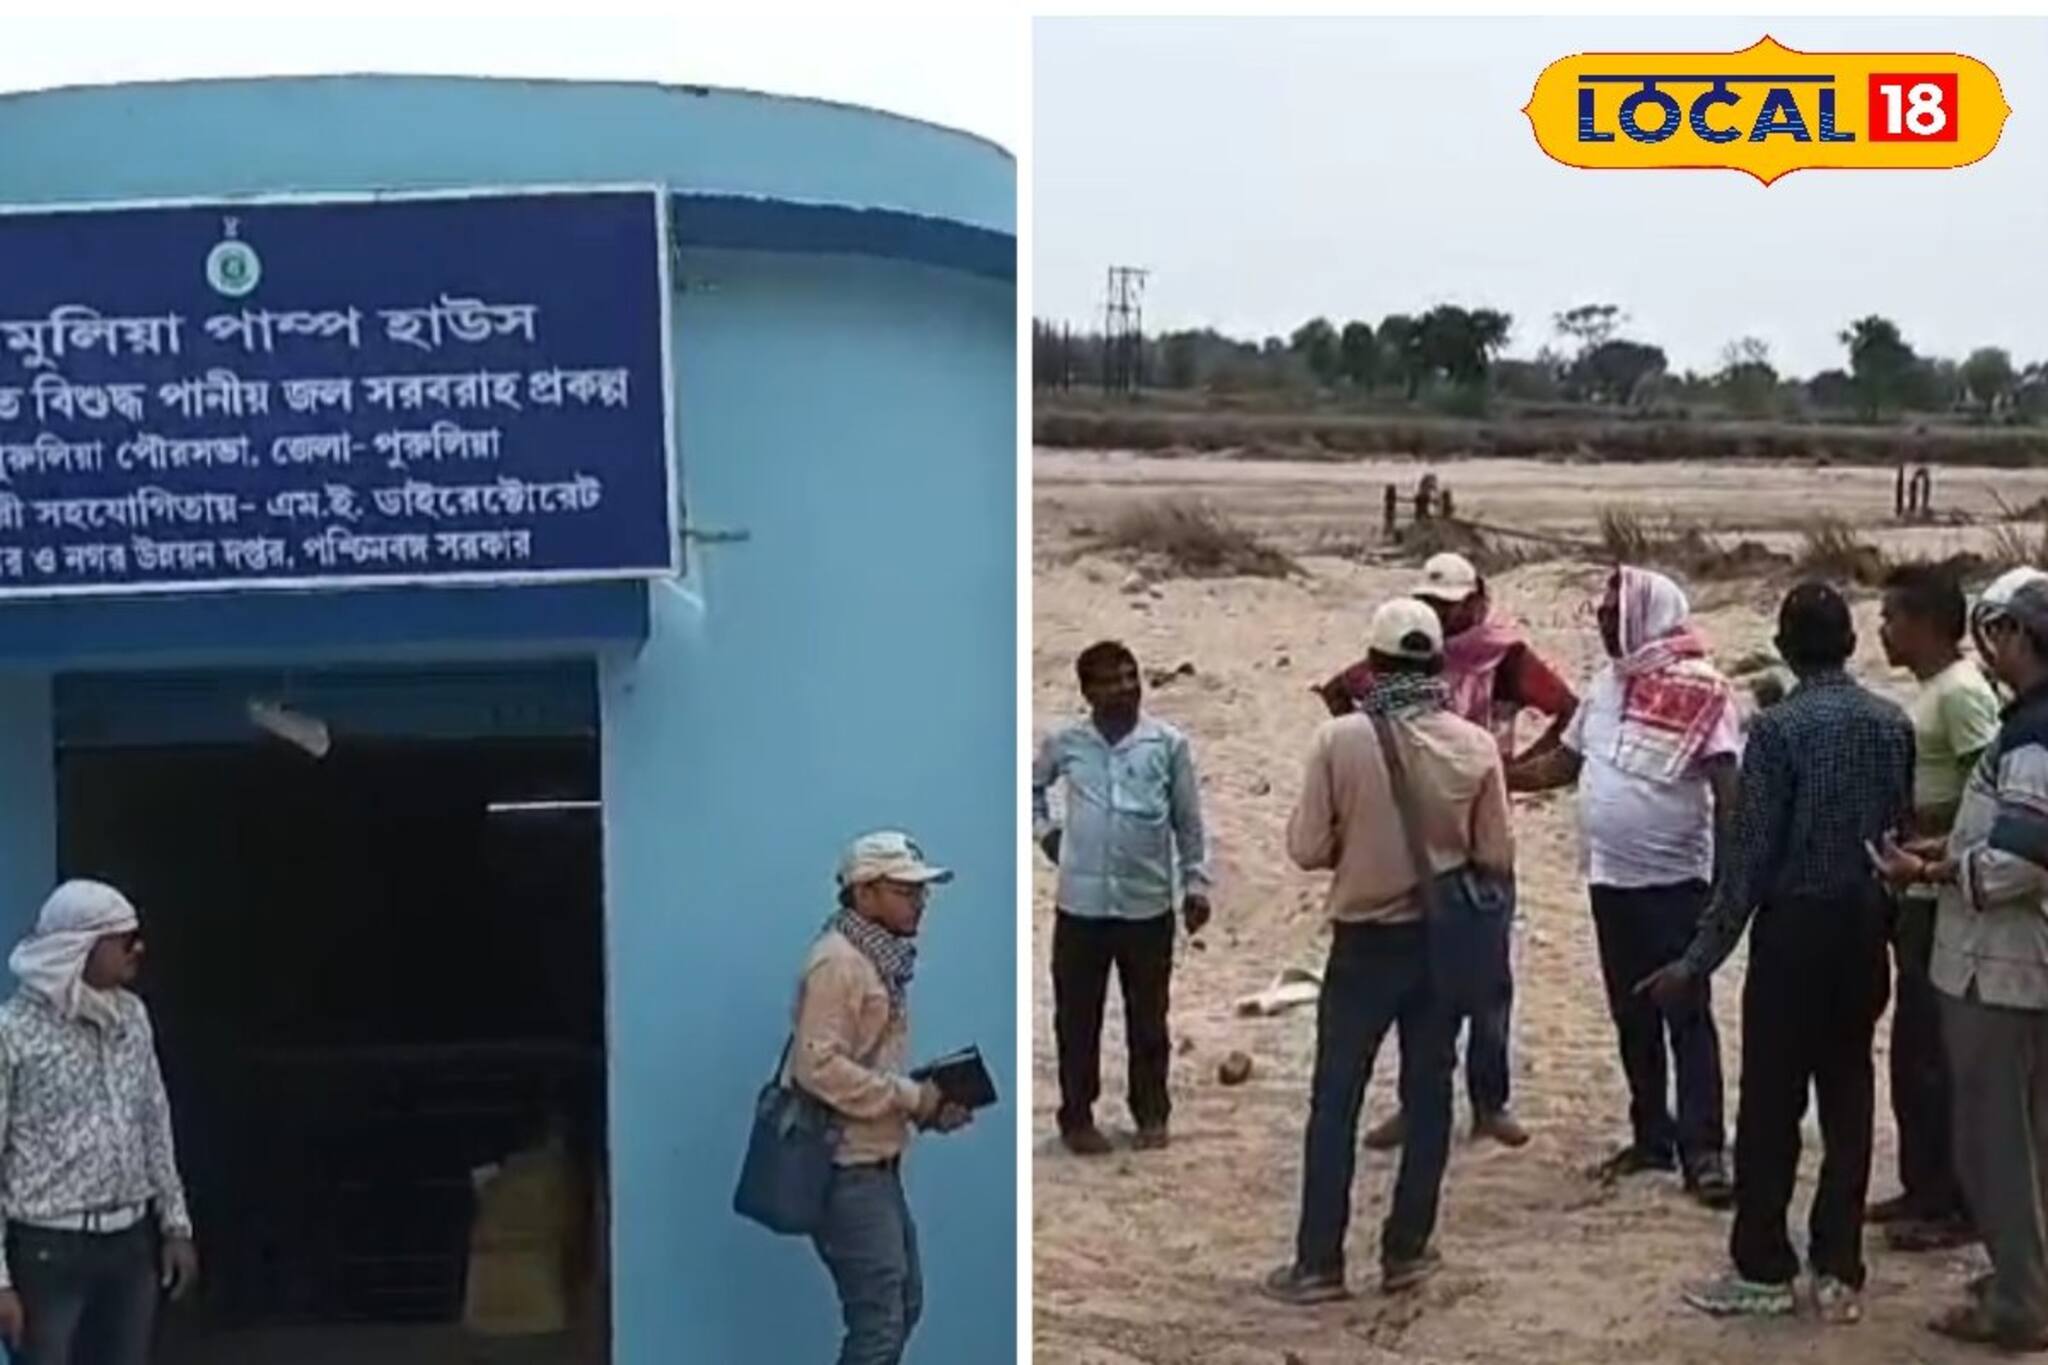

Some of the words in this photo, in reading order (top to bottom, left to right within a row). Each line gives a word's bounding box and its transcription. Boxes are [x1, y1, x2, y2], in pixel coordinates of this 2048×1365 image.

[204, 306, 360, 351] পাম্প
[376, 292, 538, 351] হাউস
[30, 373, 147, 422] বিশুদ্ধ
[158, 367, 269, 417] পানীয়
[281, 377, 353, 414] জল
[361, 368, 521, 411] সরবরাহ
[528, 366, 629, 407] প্রকল্প
[373, 420, 502, 469] পুরুলিয়া
[371, 471, 603, 520] ডাইরেক্টোরেট
[30, 546, 57, 574] ও
[61, 542, 126, 574] নগর
[434, 529, 532, 561] সরকার
